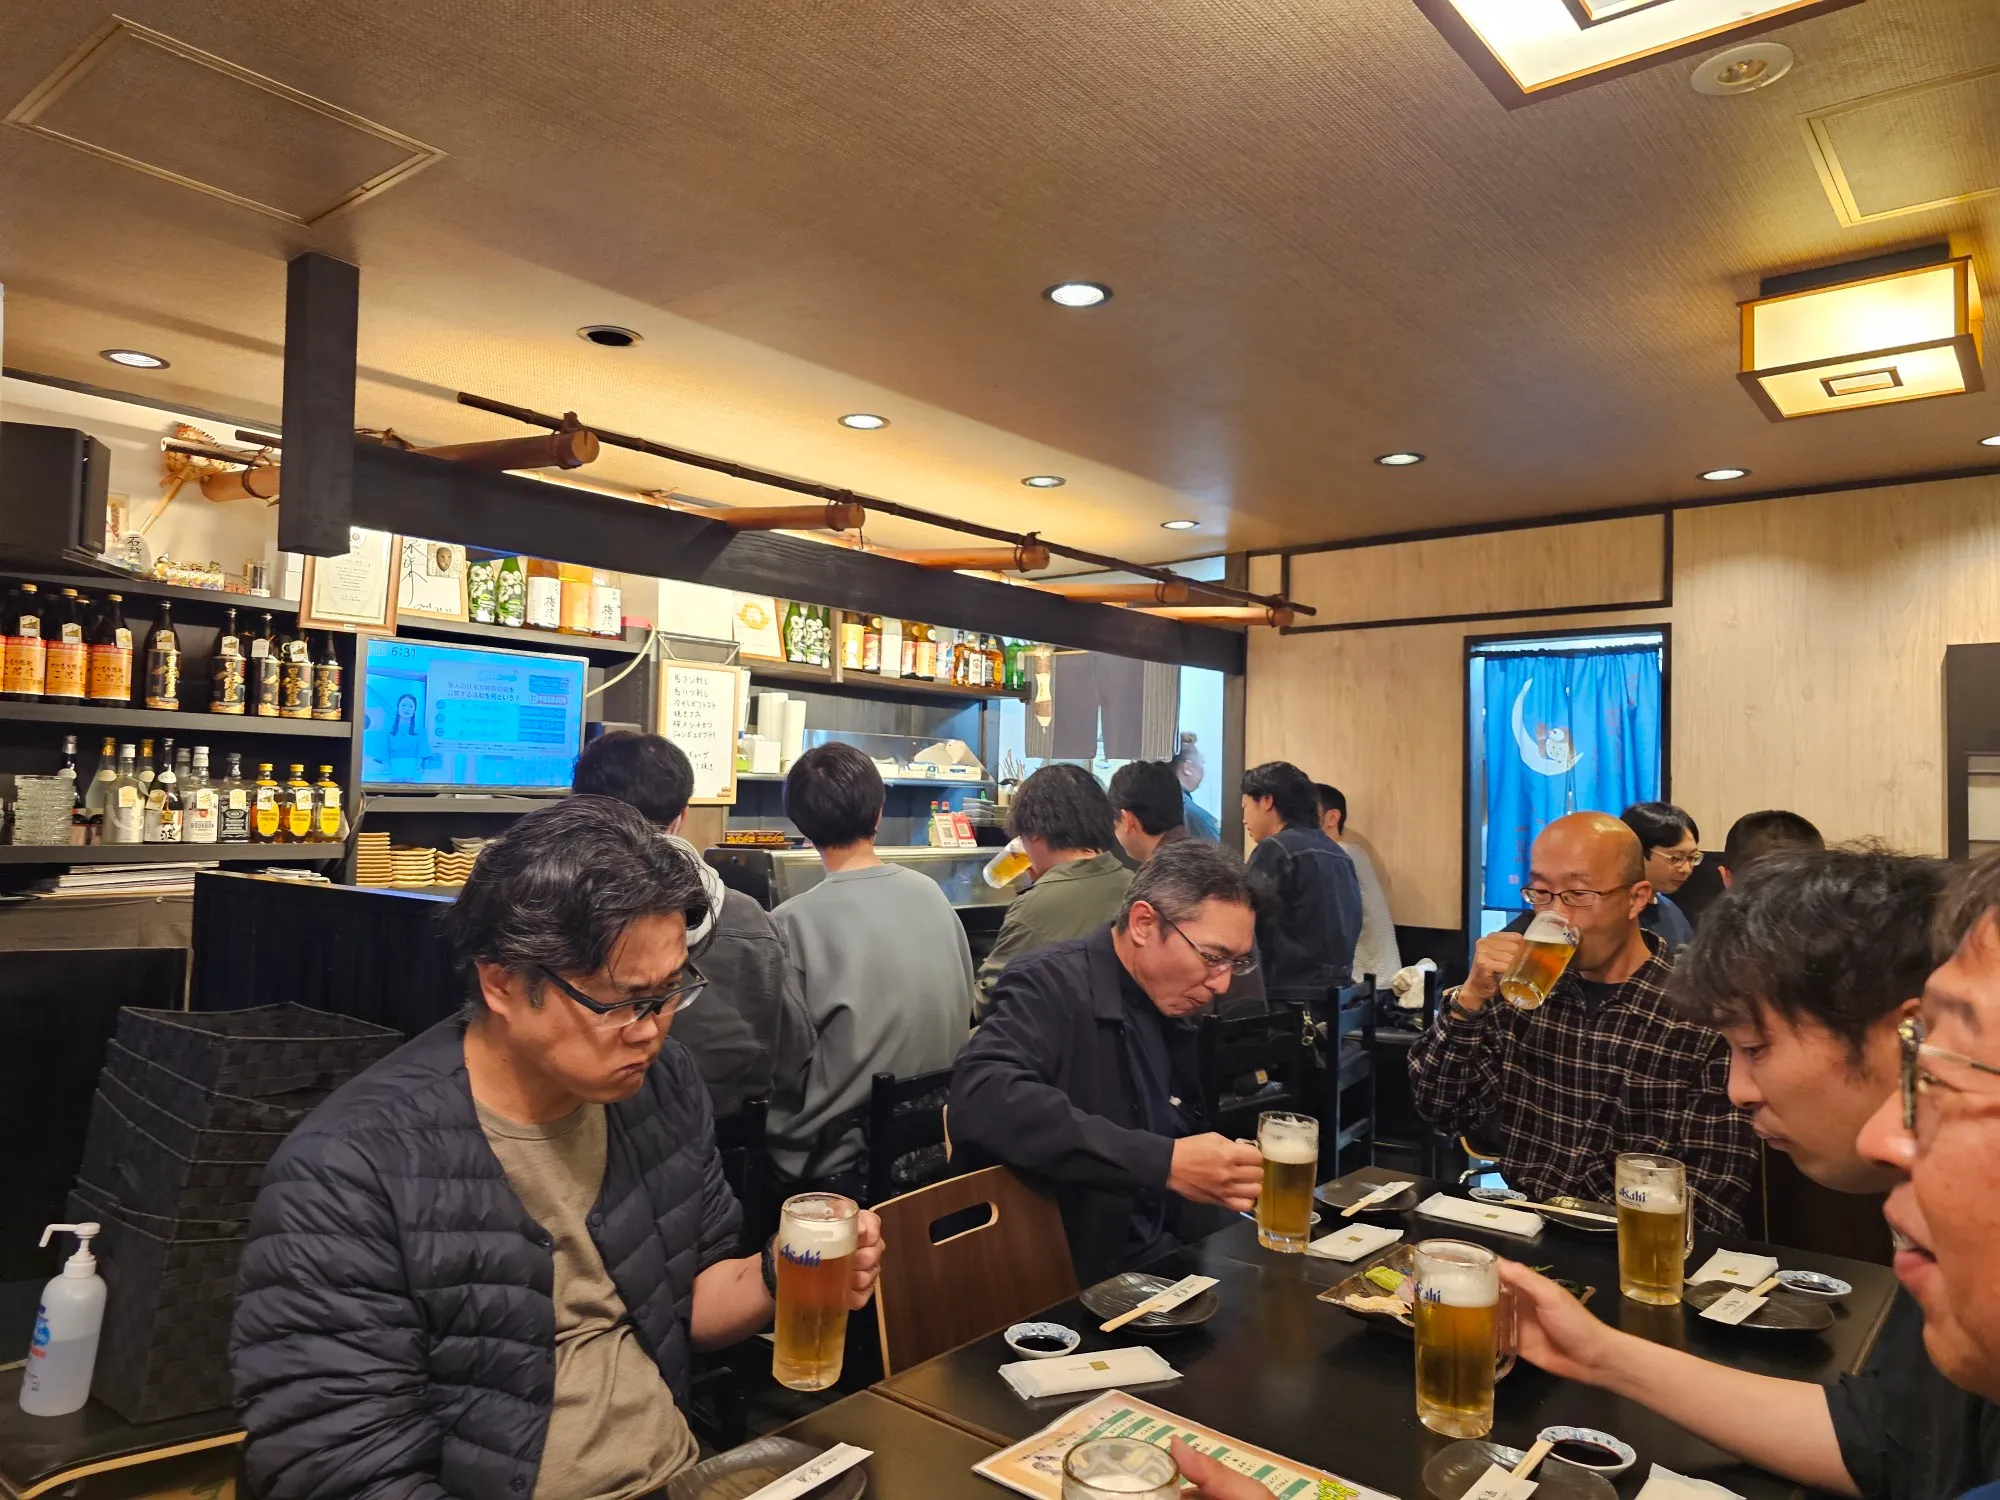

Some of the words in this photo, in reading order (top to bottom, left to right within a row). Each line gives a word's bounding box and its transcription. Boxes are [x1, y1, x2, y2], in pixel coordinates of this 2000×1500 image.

[127, 536, 142, 557] 石敢
[392, 646, 417, 658] 6:31
[780, 1243, 821, 1267] Asahi
